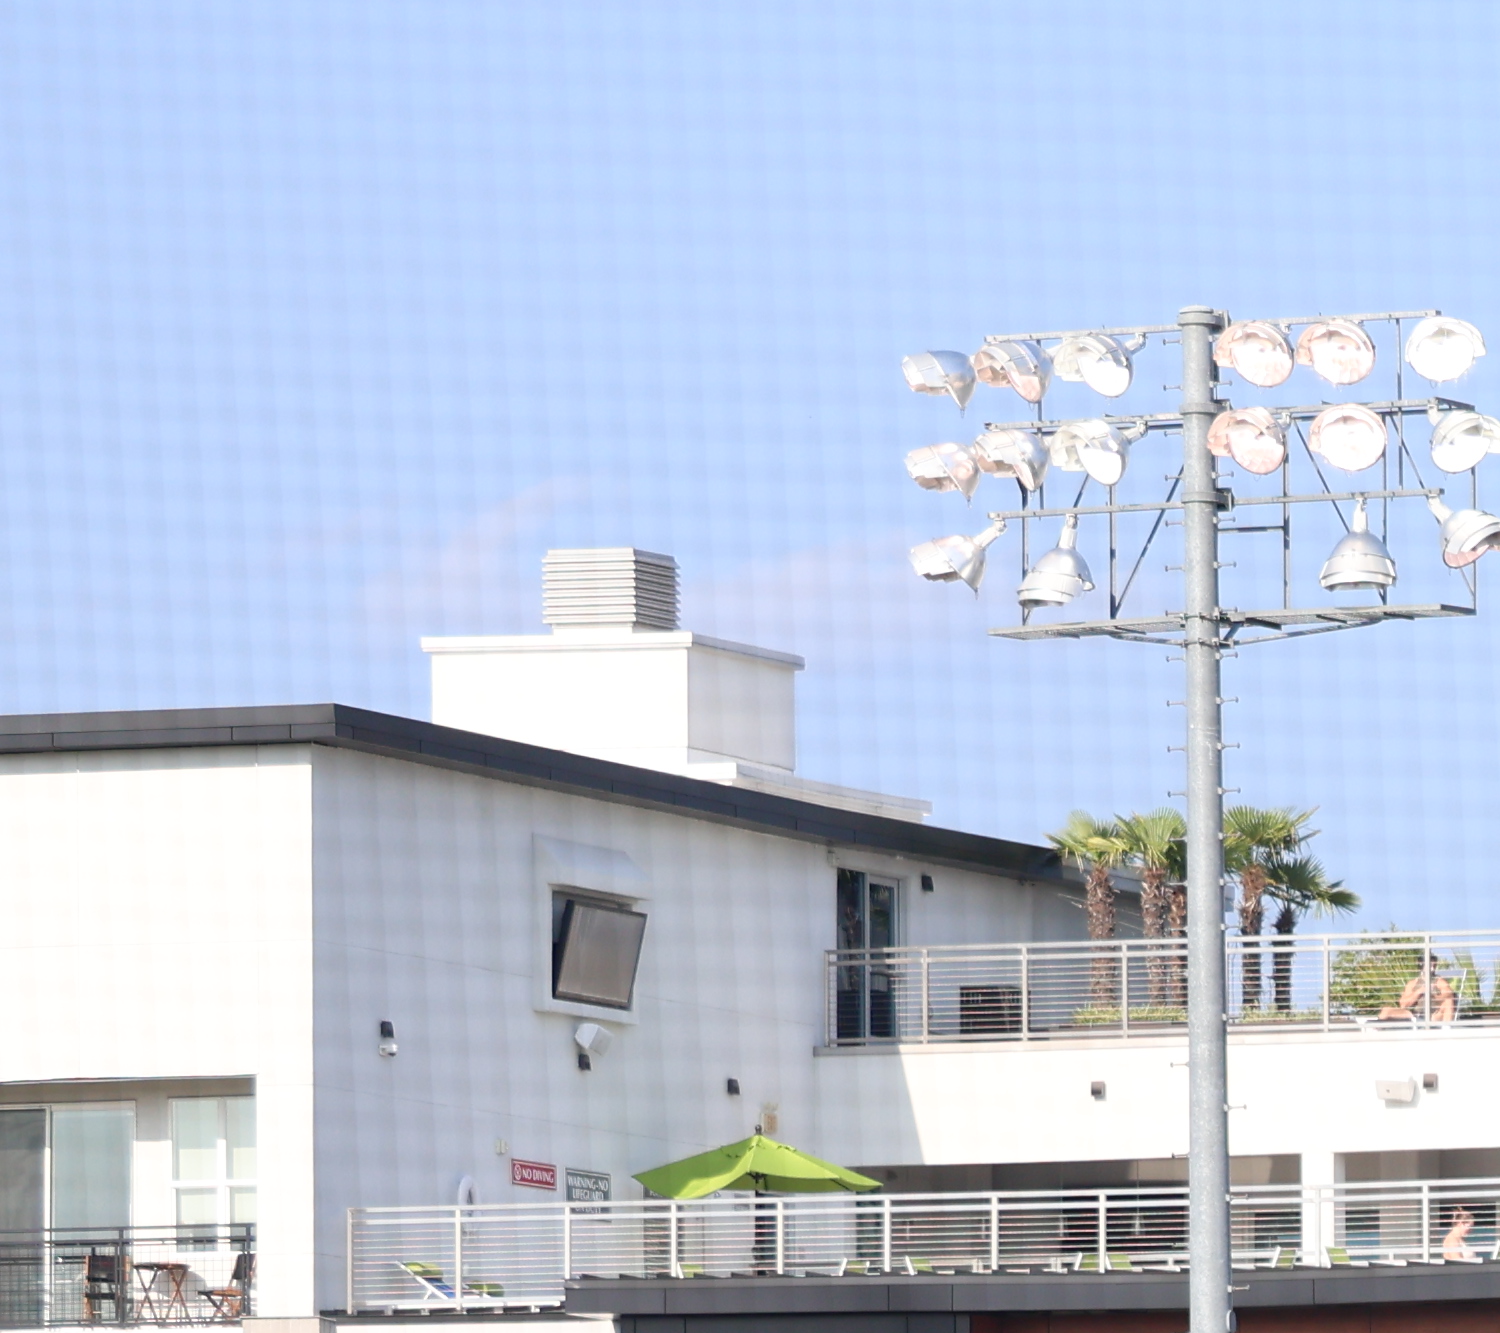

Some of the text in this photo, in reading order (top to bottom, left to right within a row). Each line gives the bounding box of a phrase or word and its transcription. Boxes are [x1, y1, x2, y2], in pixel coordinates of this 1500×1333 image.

[522, 1169, 554, 1183] NO DIVING
[573, 1188, 604, 1200] LIFEGUARD
